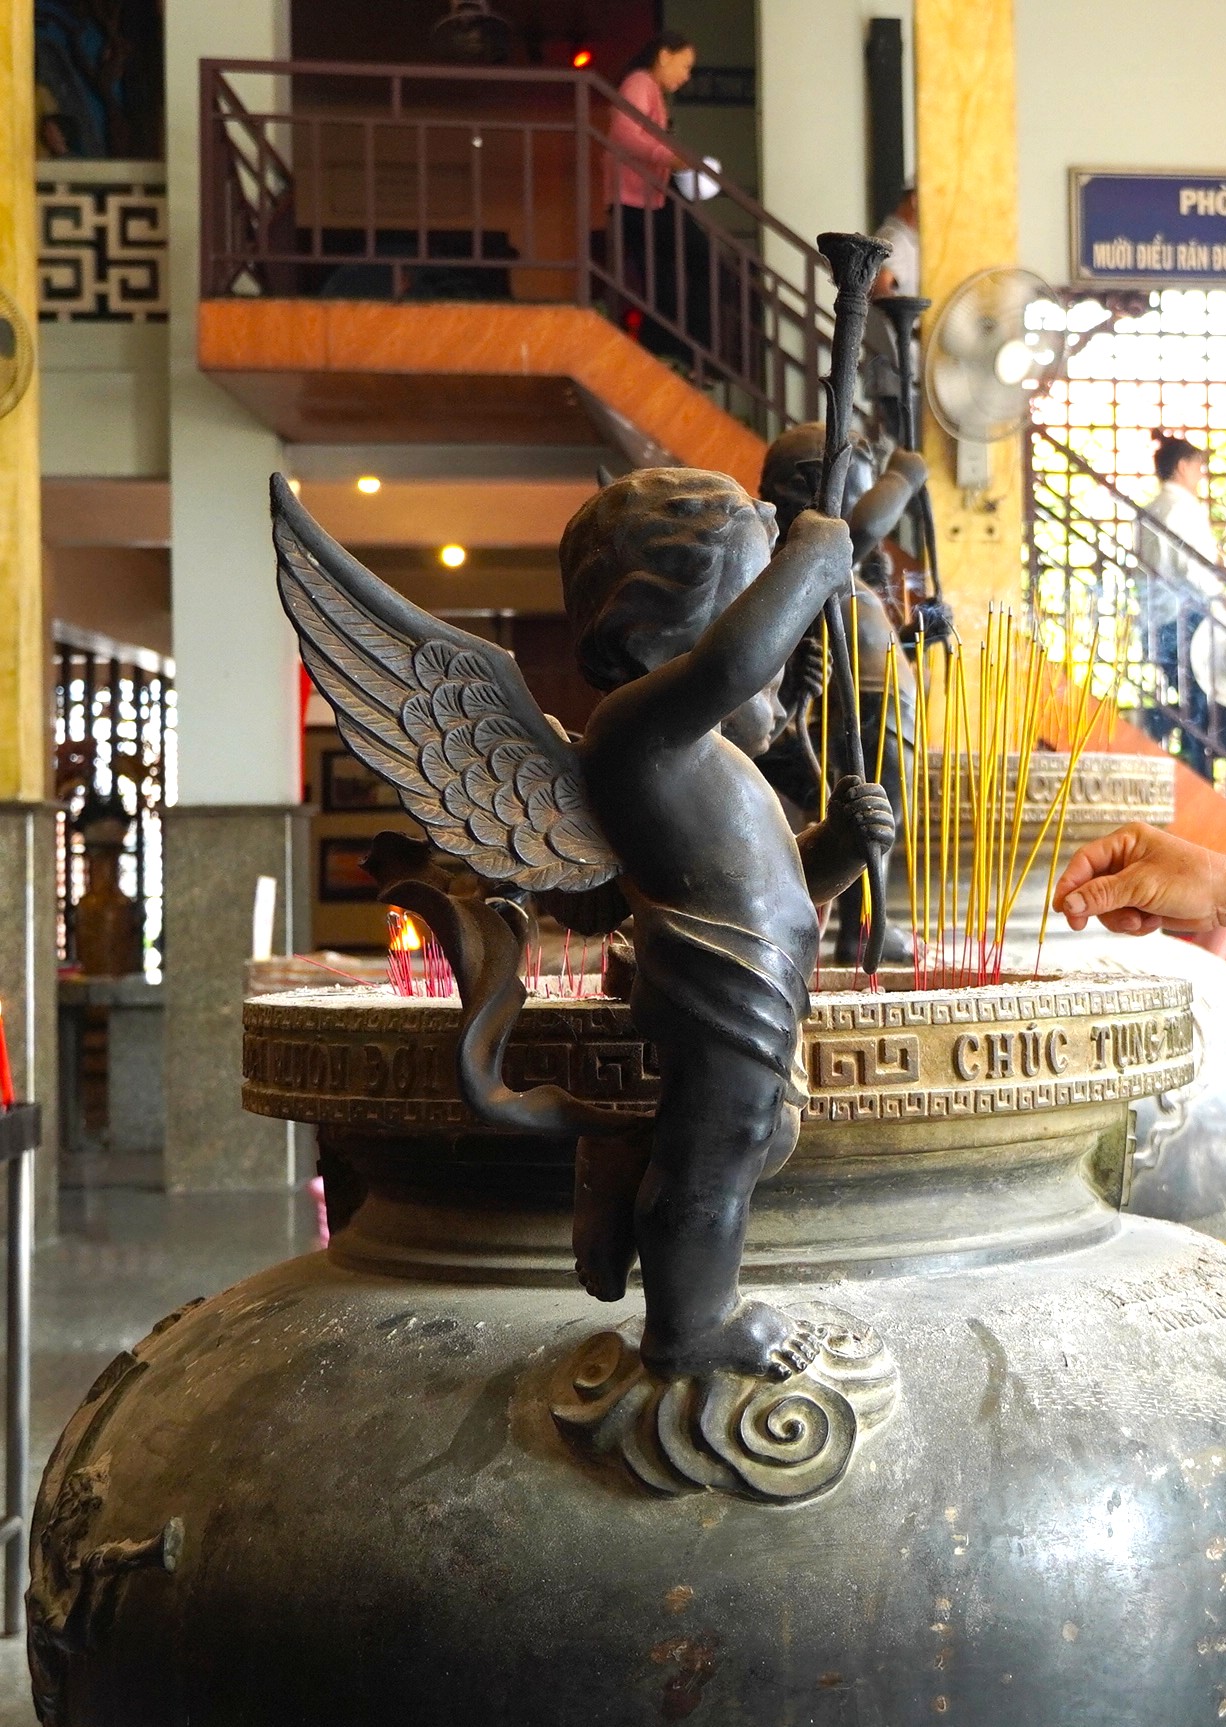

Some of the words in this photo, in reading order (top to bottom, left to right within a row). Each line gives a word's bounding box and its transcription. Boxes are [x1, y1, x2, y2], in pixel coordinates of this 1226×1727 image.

[1092, 235, 1134, 270] MƯỜI
[1136, 232, 1174, 270] ĐIỀU
[1177, 238, 1208, 271] RĂN
[954, 1021, 1069, 1082] CHÚC
[1090, 1018, 1164, 1075] TỤNG
